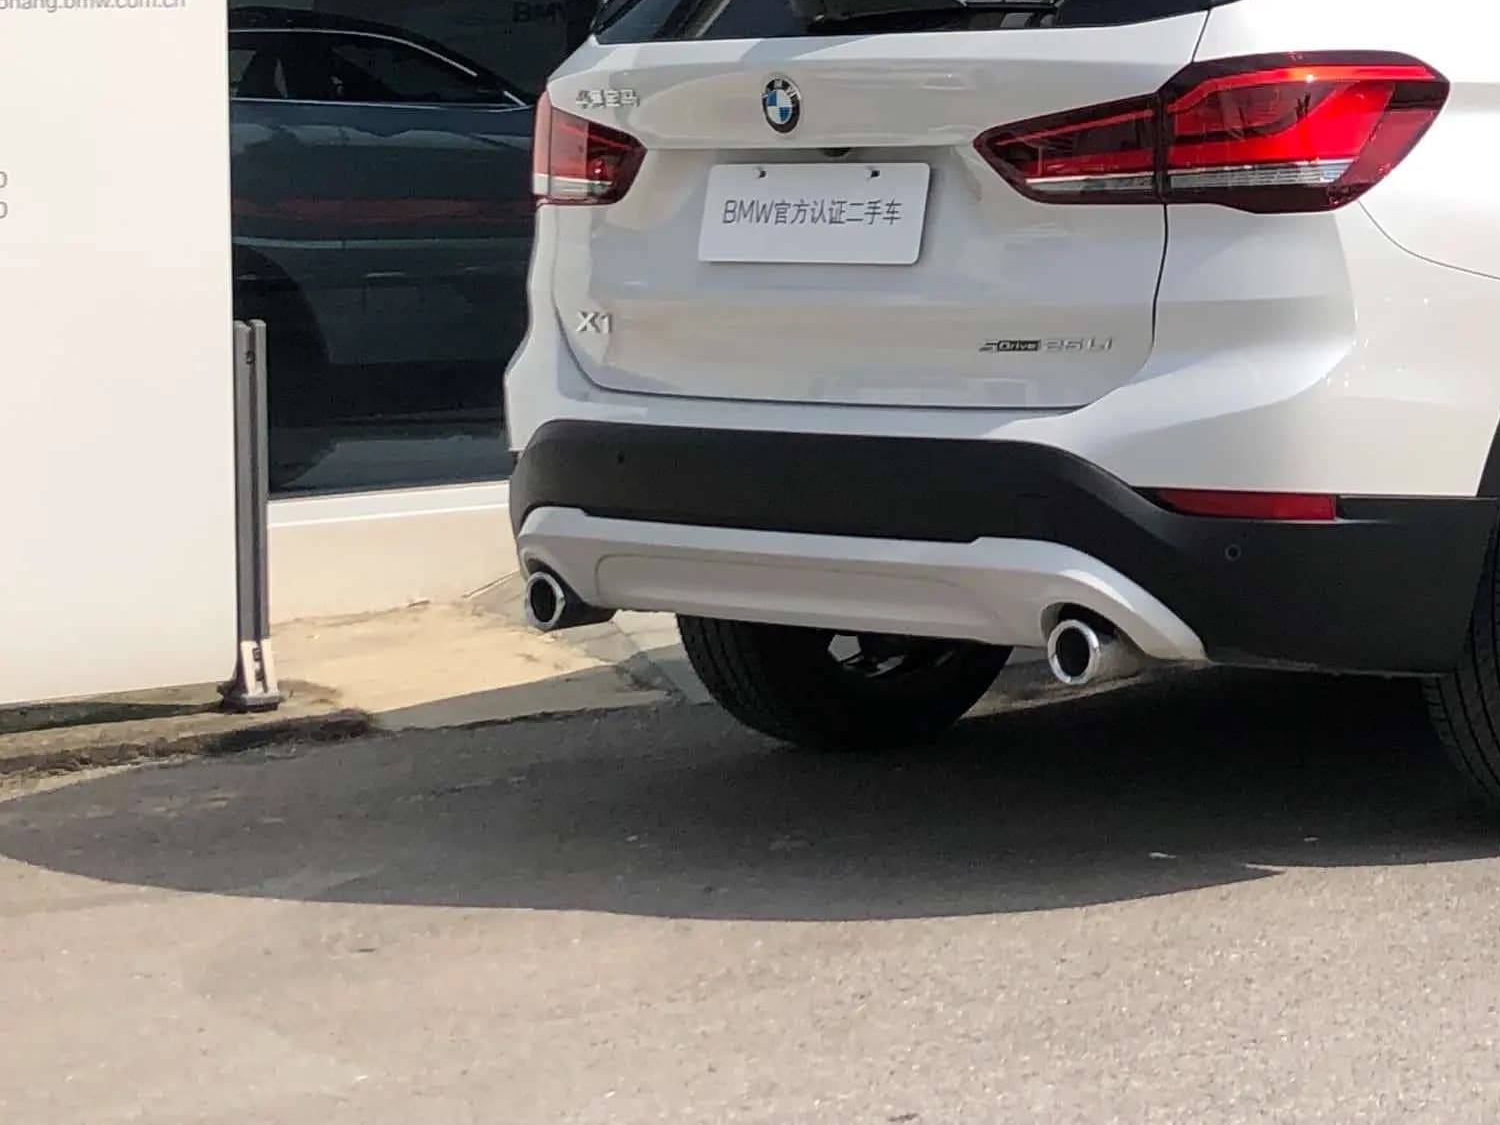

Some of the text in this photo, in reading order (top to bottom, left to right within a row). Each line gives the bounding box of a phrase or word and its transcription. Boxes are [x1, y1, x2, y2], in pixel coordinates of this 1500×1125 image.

[722, 199, 902, 225] BMW官方认证二手车
[576, 311, 612, 333] X1
